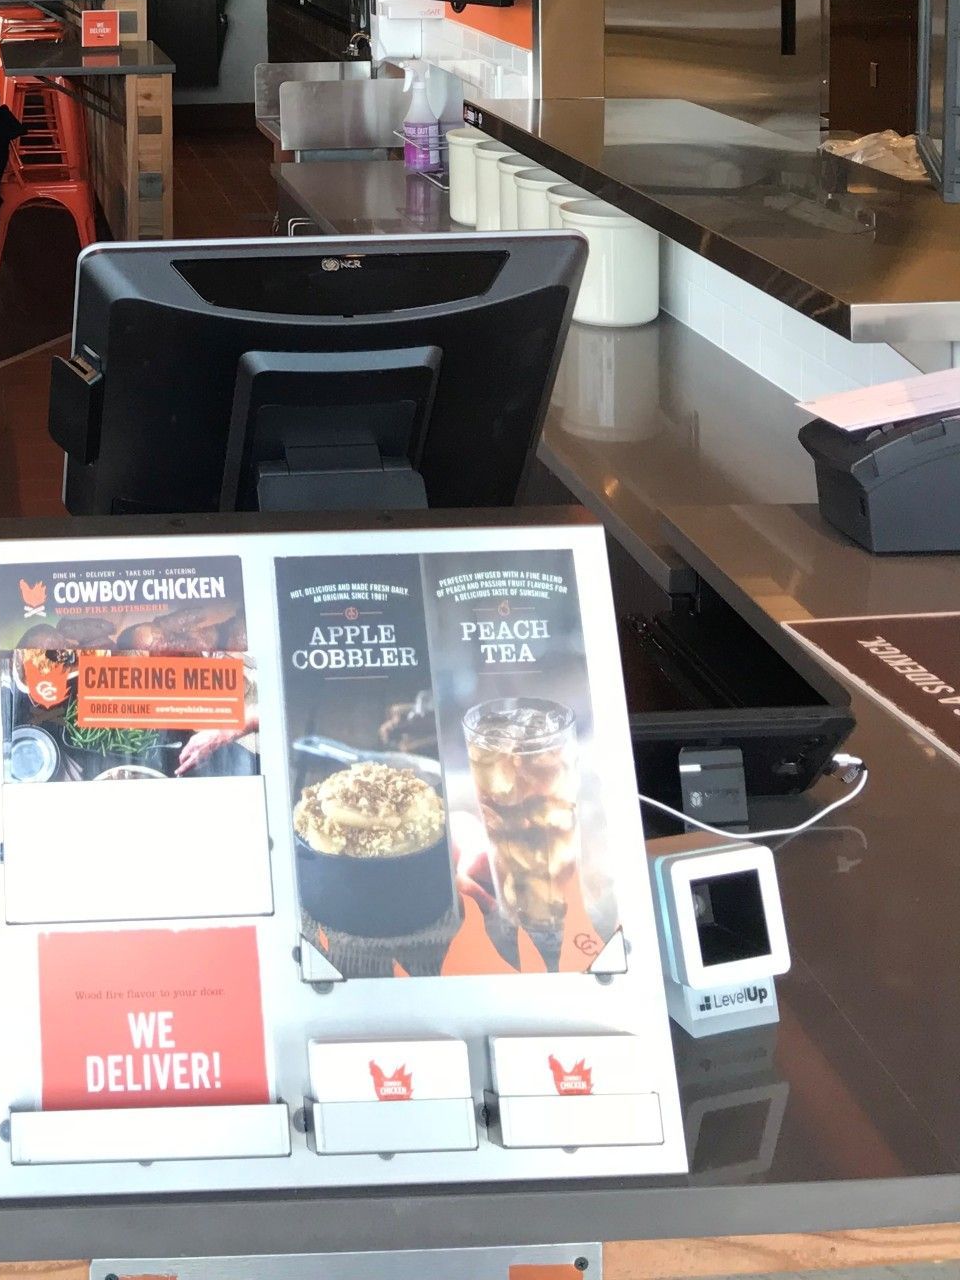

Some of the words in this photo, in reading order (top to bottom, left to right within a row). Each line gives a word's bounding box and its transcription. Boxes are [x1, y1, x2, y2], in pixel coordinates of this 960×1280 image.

[340, 259, 362, 269] NCR
[53, 571, 67, 580] DINE
[68, 571, 76, 579] IN
[86, 570, 116, 578] DELIVERY
[125, 569, 141, 577] TAKE
[165, 567, 196, 575] CATERING
[438, 573, 474, 588] PERFECTLY
[474, 570, 502, 580] INFUSED
[502, 570, 520, 579] WITH
[526, 572, 541, 581] FINE
[542, 573, 563, 584] BLEND
[54, 579, 138, 605] COWBOY
[142, 576, 226, 602] CHICKEN
[305, 584, 337, 596] DELICIOUS
[337, 583, 351, 591] AND
[351, 582, 369, 591] MADE
[370, 583, 390, 592] FRESH
[313, 595, 322, 603] AN
[323, 593, 350, 602] ORIGINAL
[351, 592, 369, 601] SINCE
[436, 589, 445, 598] OF
[445, 584, 467, 596] PEACH
[467, 582, 479, 590] AND
[480, 580, 507, 588] PASSION
[527, 581, 554, 591] FLAVORS
[554, 584, 568, 594] FOR
[460, 588, 491, 601] DELICIOUS
[491, 588, 509, 596] TASTE
[509, 588, 518, 596] OF
[519, 588, 550, 600] SUNSHINE.
[55, 606, 82, 616] WOOD
[84, 605, 108, 614] FIRE
[111, 603, 169, 613] ROTISSERIE
[309, 624, 396, 646] APPLE
[460, 620, 551, 641] PEACH
[292, 647, 419, 670] COBBLER
[480, 643, 537, 664] TEA
[83, 665, 177, 690] CATERING
[183, 668, 237, 691] MENU
[90, 703, 119, 715] ORDER
[121, 703, 151, 715] ONLINE
[75, 990, 102, 1001] Wood
[106, 989, 124, 1000] fire
[127, 989, 156, 999] flavor
[160, 988, 170, 998] to
[173, 989, 197, 1001] your
[200, 986, 226, 997] door.
[713, 985, 768, 1009] LevelUp
[128, 1011, 176, 1049] WE
[86, 1051, 222, 1093] DELIVER!
[380, 1086, 407, 1095] CHICKEN
[559, 1080, 587, 1090] CHICKEN
